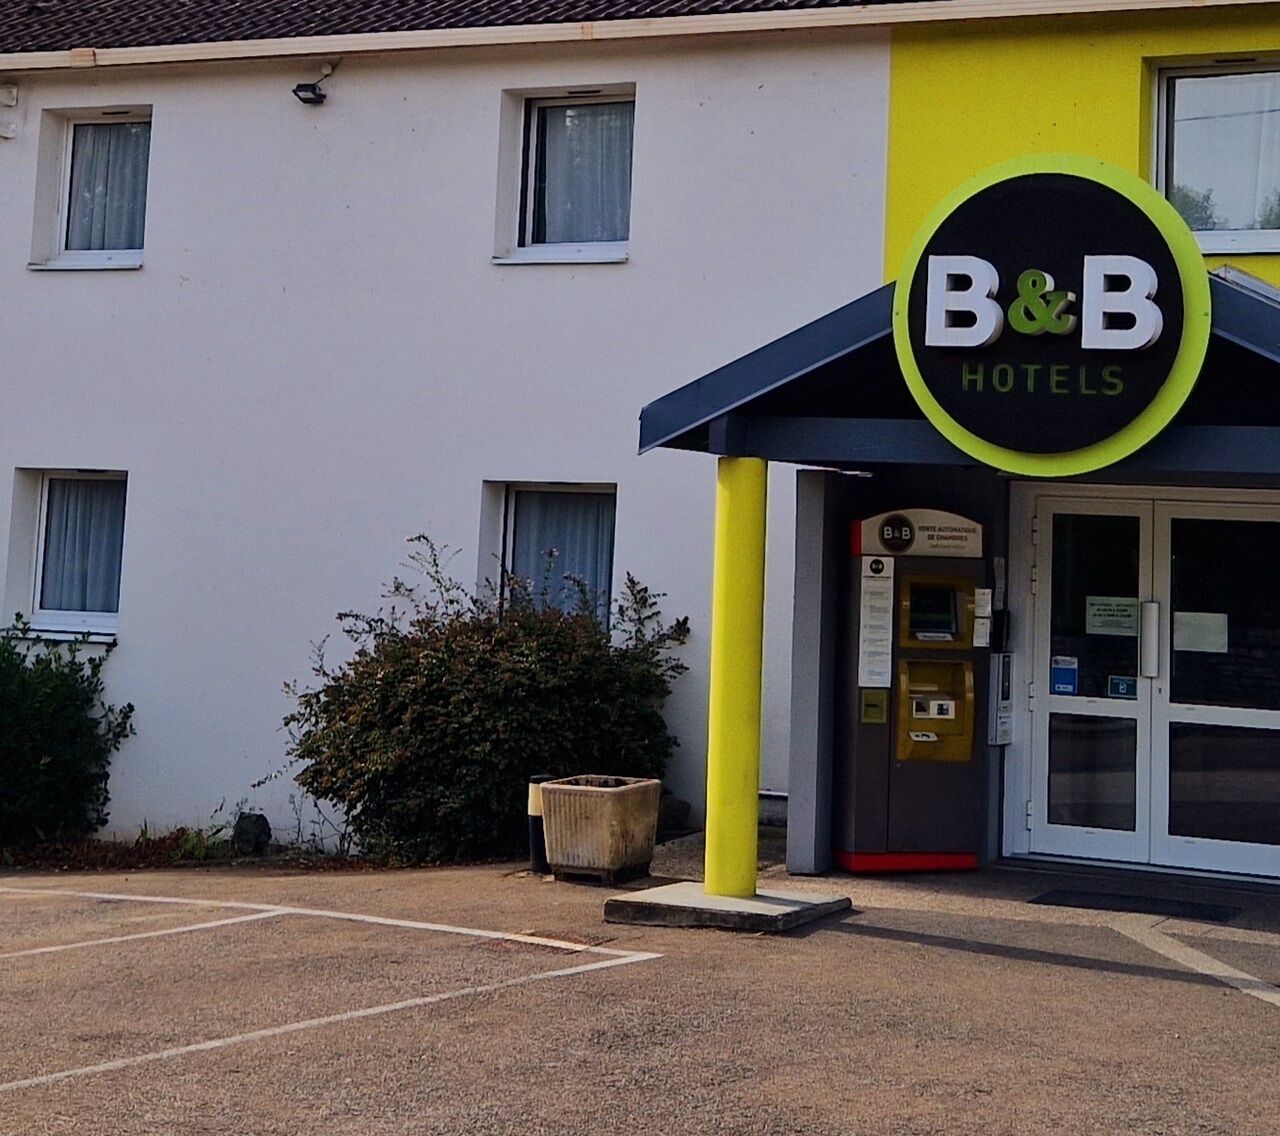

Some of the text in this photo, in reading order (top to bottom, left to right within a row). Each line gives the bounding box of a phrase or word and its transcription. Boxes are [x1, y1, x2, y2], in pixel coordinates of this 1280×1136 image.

[924, 254, 1164, 350] B&B
[961, 364, 1125, 396] HOTELS
[883, 525, 911, 540] B&B
